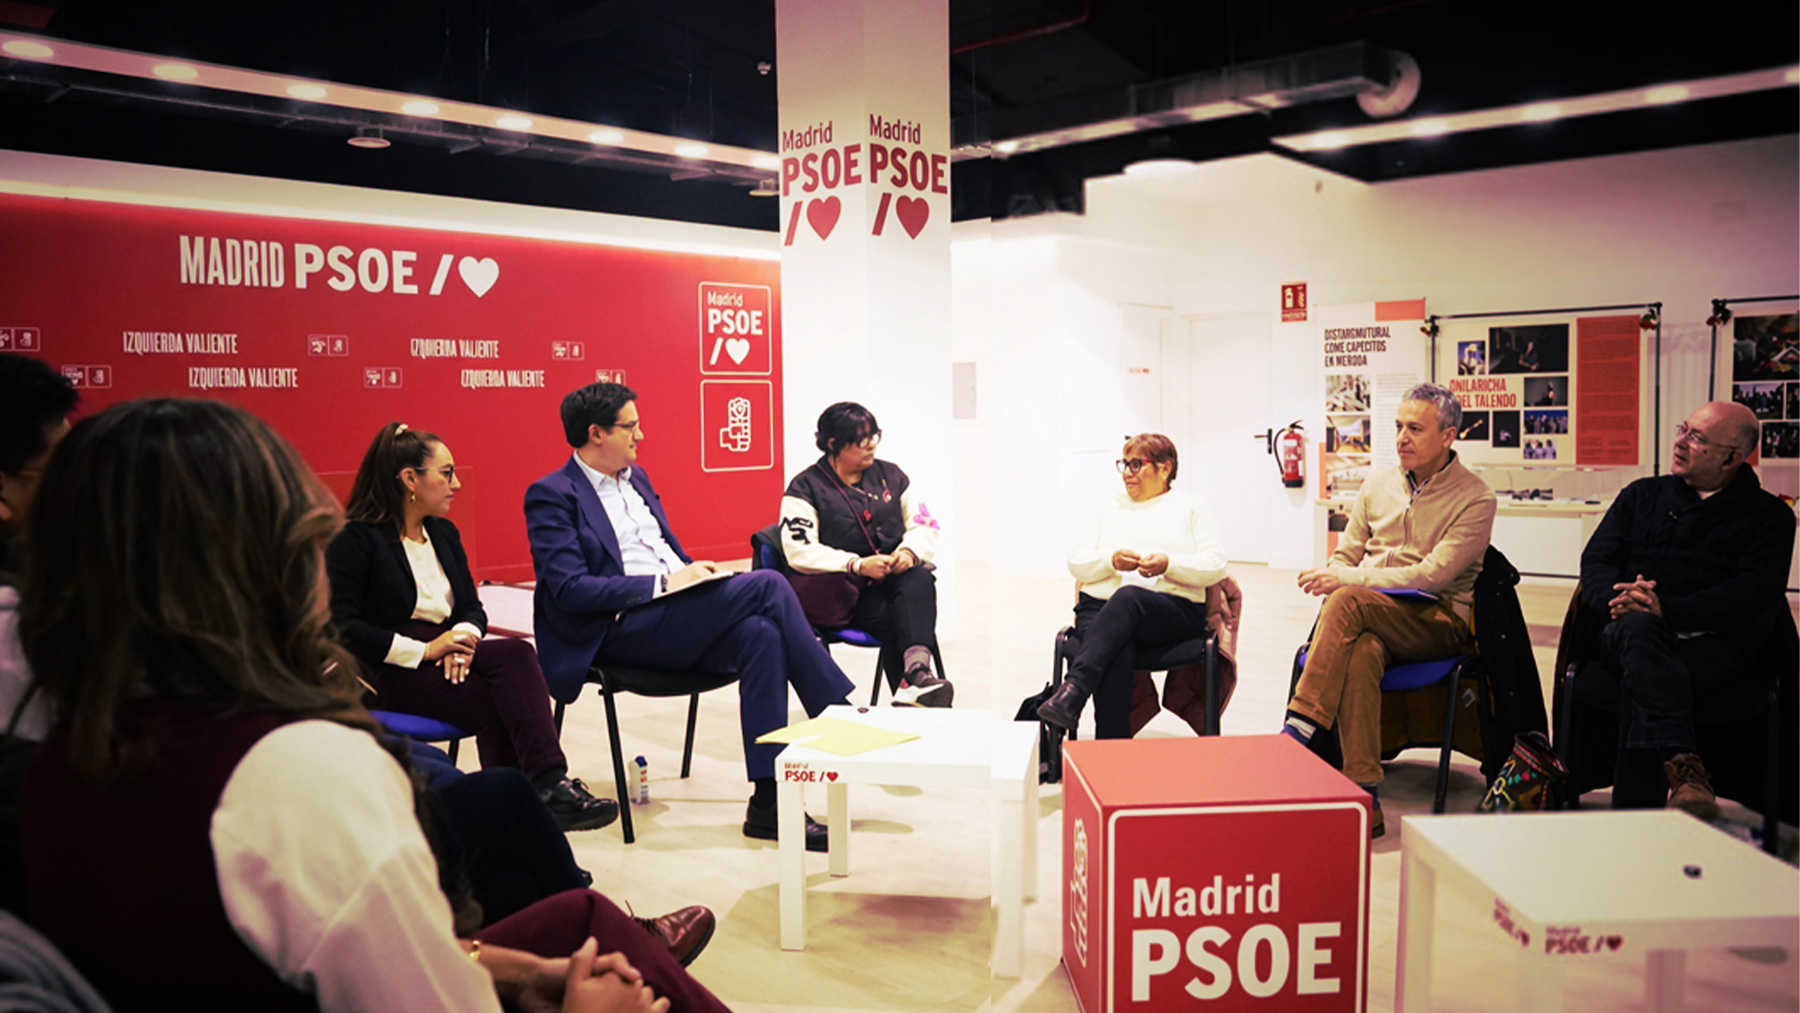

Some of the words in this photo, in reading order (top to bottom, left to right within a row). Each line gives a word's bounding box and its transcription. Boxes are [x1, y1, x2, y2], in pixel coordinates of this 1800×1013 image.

[782, 120, 833, 152] Madrid
[869, 113, 921, 145] Madrid
[782, 143, 862, 197] PSOE
[869, 143, 948, 194] PSOE
[180, 235, 284, 288] MADRID
[294, 243, 419, 295] PSOE
[707, 291, 743, 308] Madrid
[707, 308, 763, 336] PSOE
[123, 331, 183, 356] IZQUIERDA
[186, 333, 239, 354] VALIENTE
[410, 338, 457, 359] IZQUIERDA
[459, 339, 500, 358] VALIENTE
[189, 367, 246, 390] IZQUIERDA
[248, 368, 298, 388] VALIENTE
[461, 369, 506, 390] IZQUIERDA
[506, 369, 545, 388] VALIENTE
[1474, 392, 1517, 408] TALENDO
[785, 770, 816, 782] PSOE
[1132, 873, 1280, 919] Madrid
[1131, 922, 1342, 1002] PSOE
